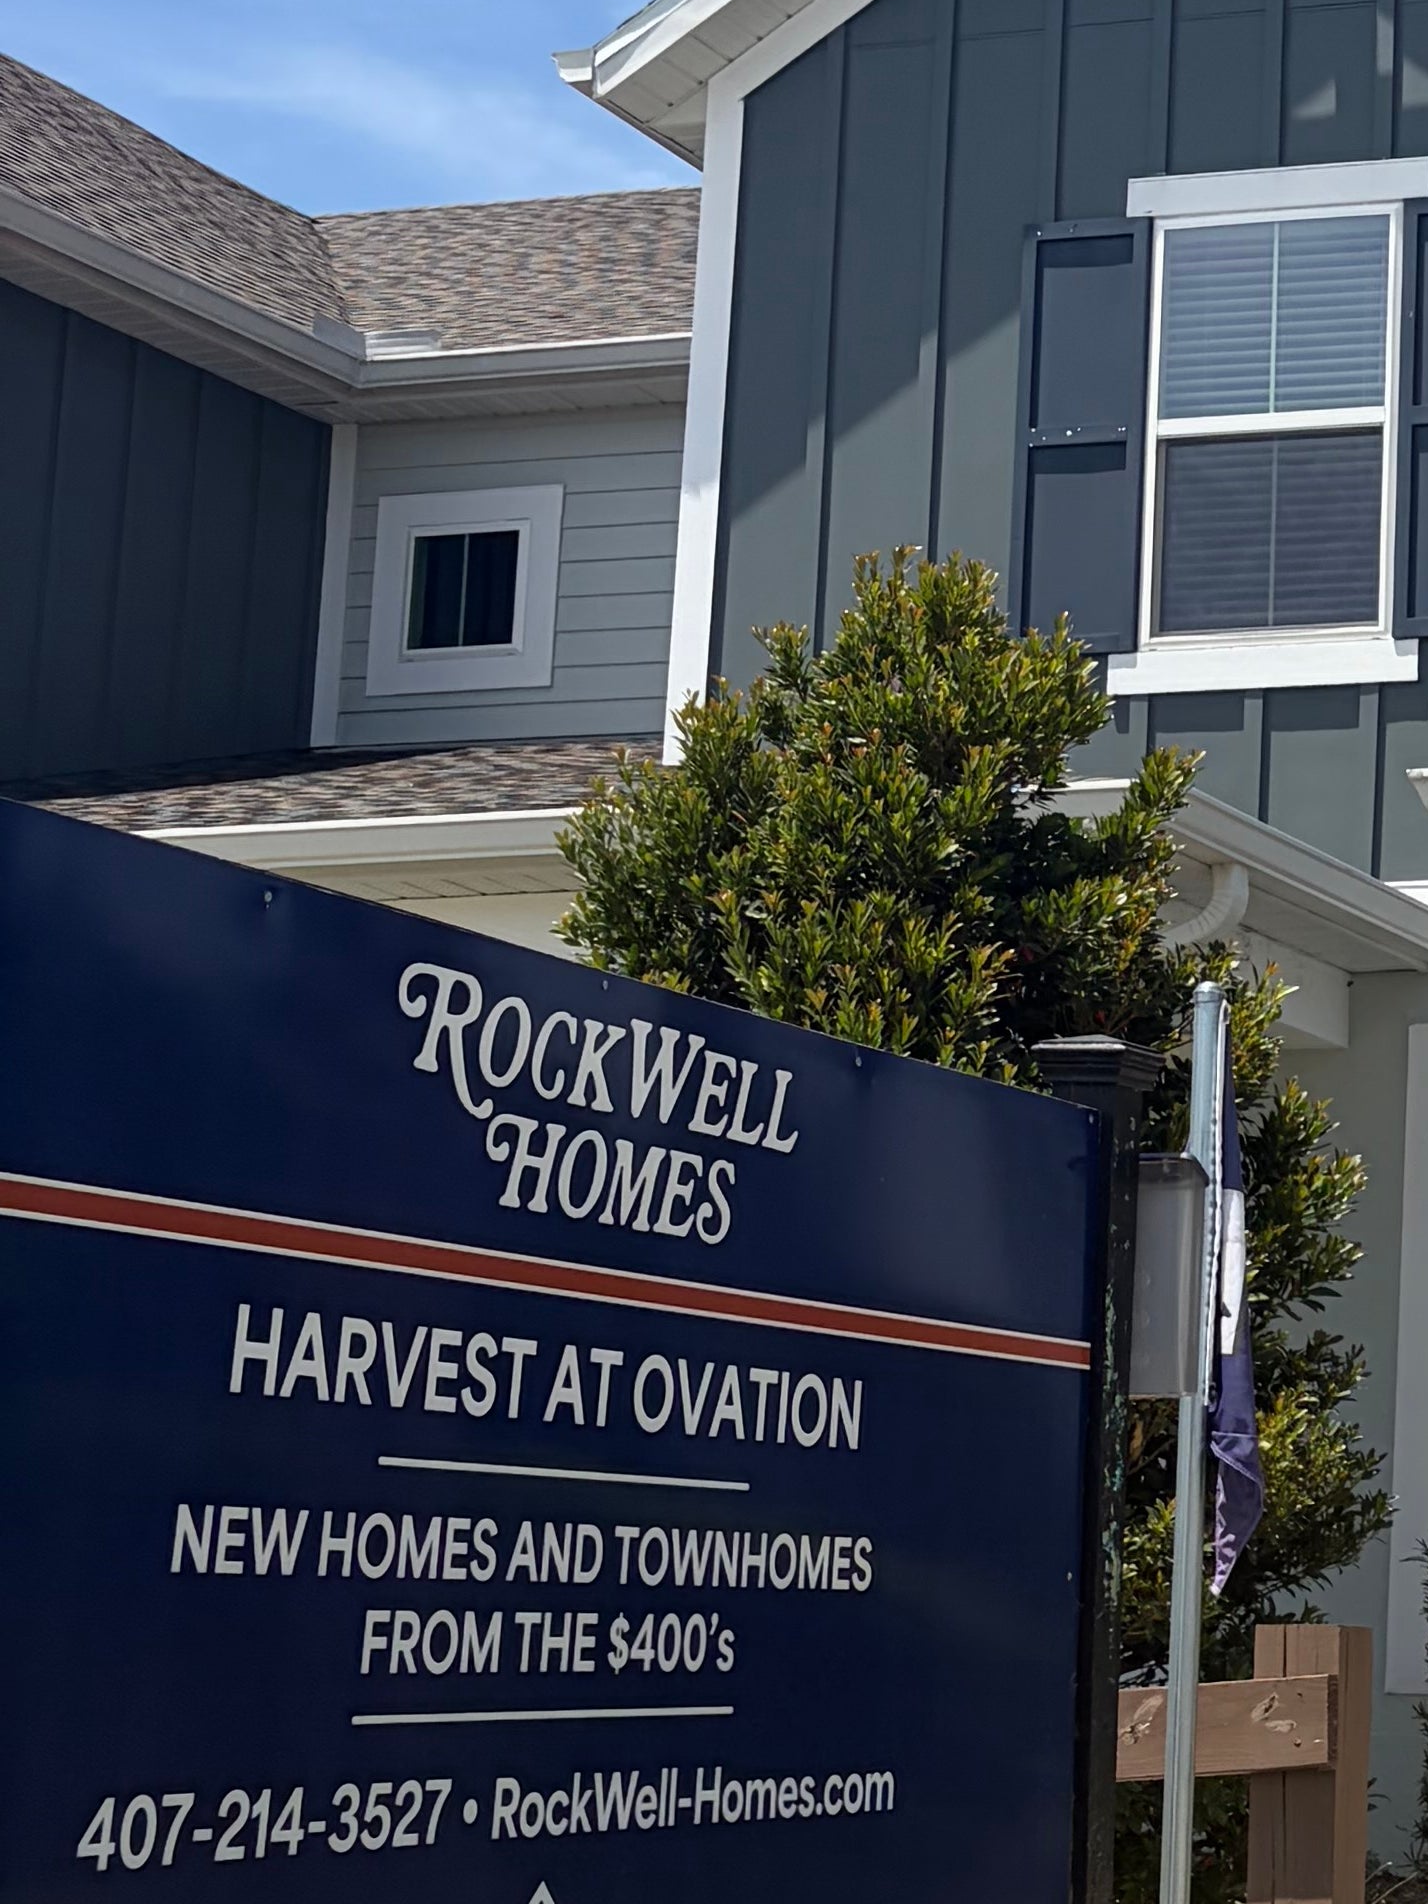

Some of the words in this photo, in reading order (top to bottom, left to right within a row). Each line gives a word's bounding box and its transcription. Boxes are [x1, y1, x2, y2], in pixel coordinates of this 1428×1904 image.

[486, 1113, 736, 1245] HOMES
[230, 1303, 538, 1419] HARVEST
[543, 1344, 624, 1427] AT
[633, 1354, 863, 1450] OVATION
[171, 1504, 310, 1575] NEW
[318, 1511, 498, 1581] HOMES
[506, 1521, 603, 1583] AND
[615, 1525, 873, 1592] TOWNHOMES
[360, 1609, 503, 1675] FROM
[515, 1612, 599, 1673] THE
[77, 1779, 452, 1871] 407-214-3527
[491, 1766, 894, 1839] RockWell-Homes.com
